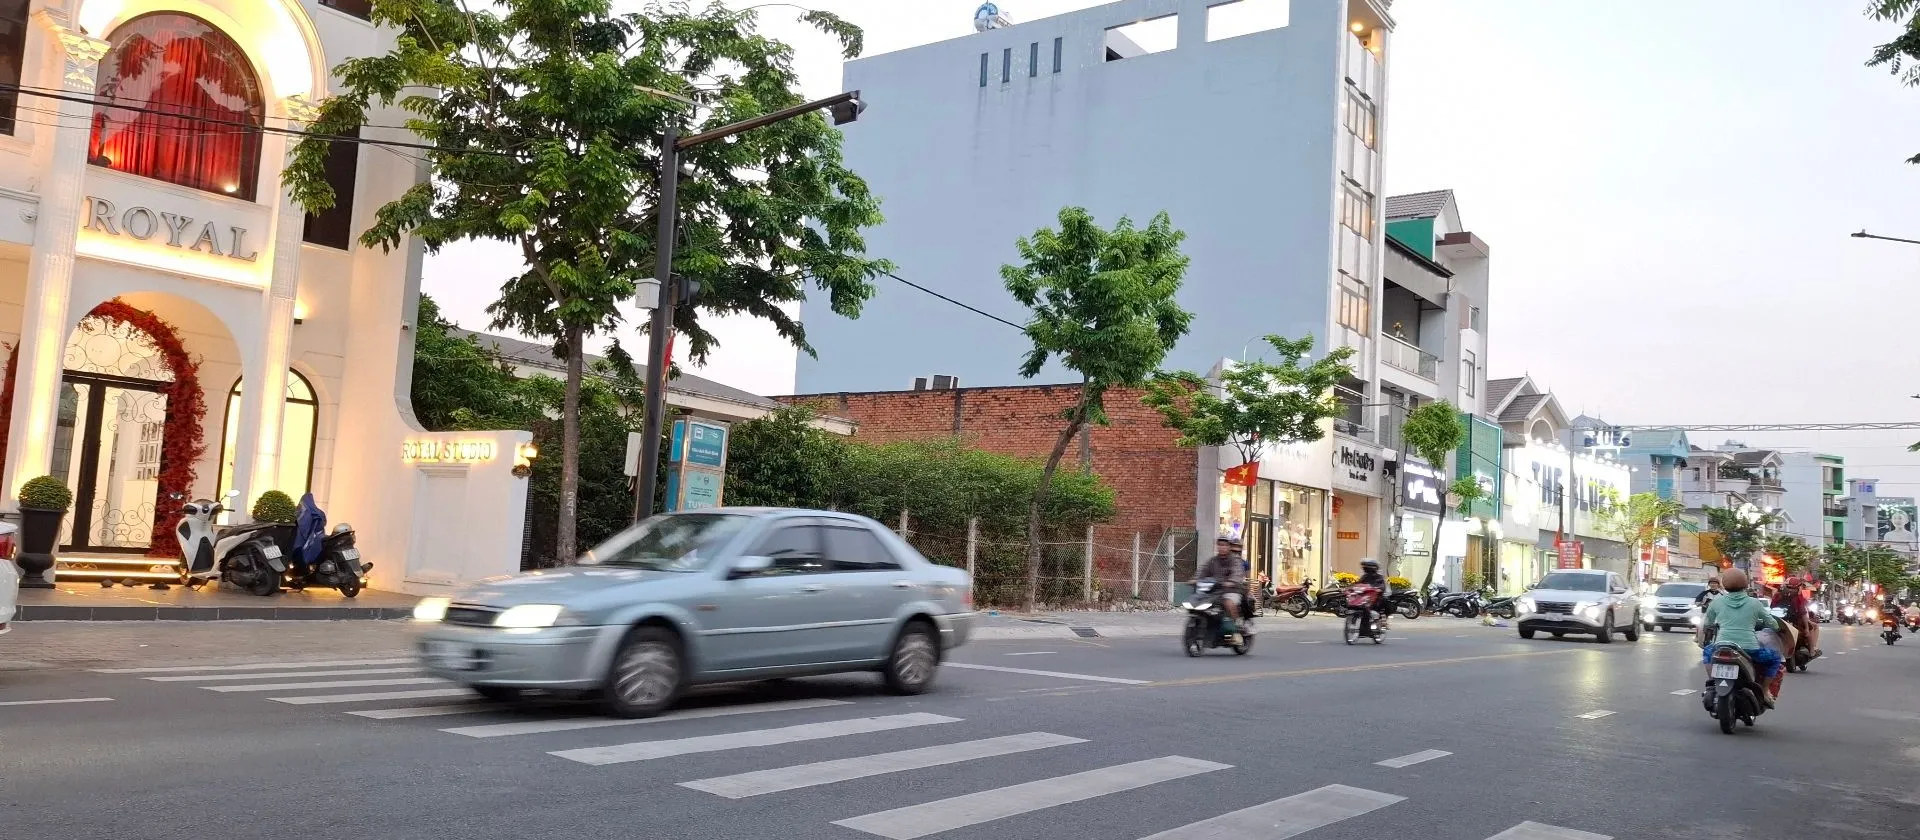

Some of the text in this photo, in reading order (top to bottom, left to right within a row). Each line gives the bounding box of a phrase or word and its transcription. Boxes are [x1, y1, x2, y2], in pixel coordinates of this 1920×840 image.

[84, 196, 258, 262] ROYAL
[401, 442, 492, 460] ROYAL STUDIO
